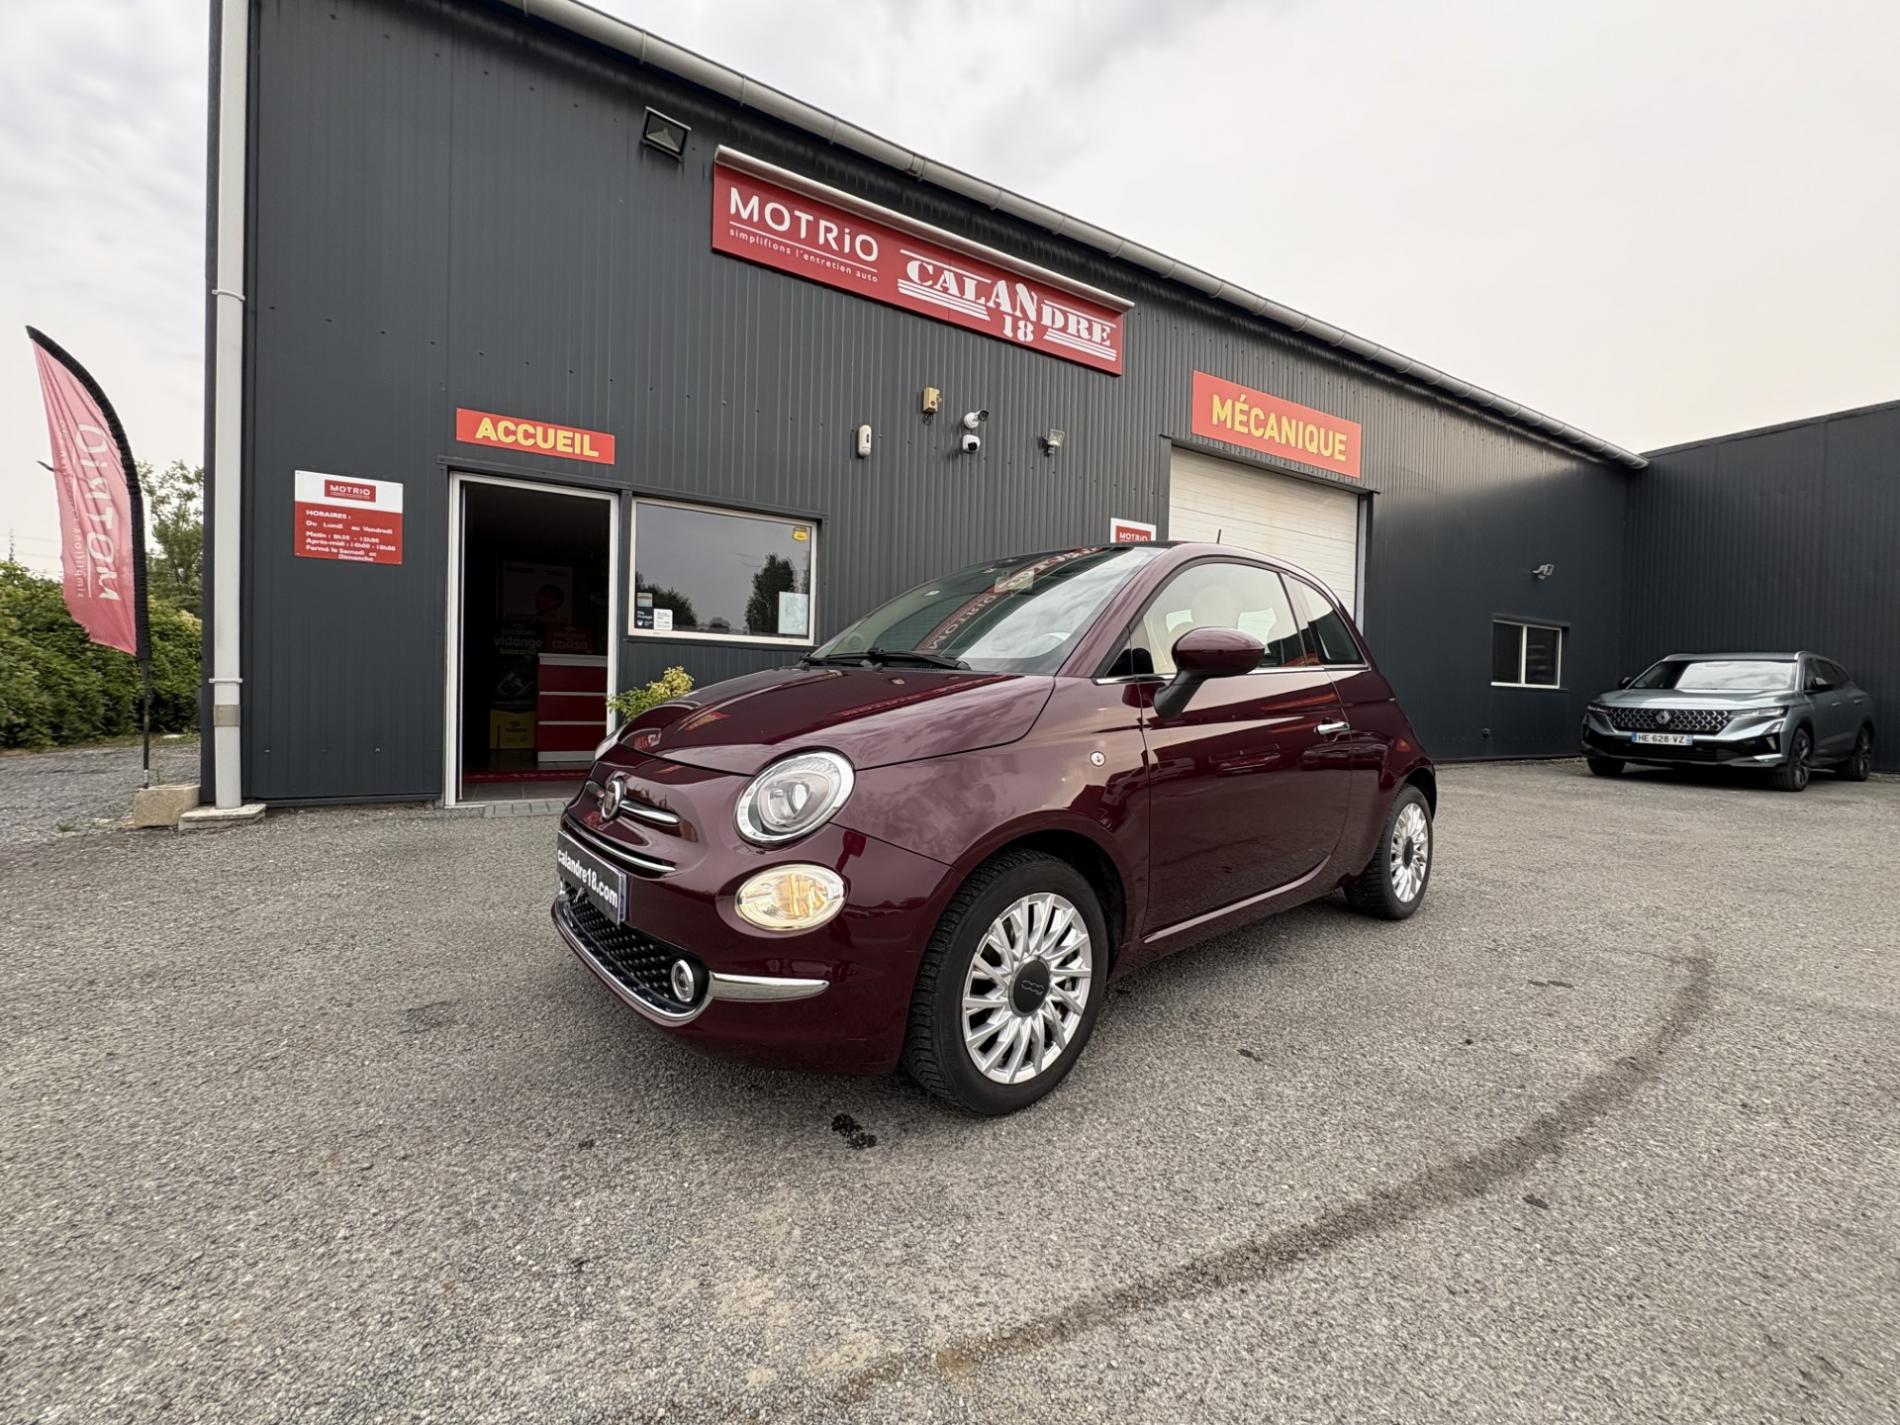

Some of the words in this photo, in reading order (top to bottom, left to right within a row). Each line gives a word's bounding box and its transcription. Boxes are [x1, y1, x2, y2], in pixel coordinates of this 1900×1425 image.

[729, 228, 791, 254] simplifions
[795, 248, 852, 275] l'entretien
[856, 269, 878, 283] auto
[906, 260, 1111, 347] CALANDRE
[1002, 314, 1034, 343] 18
[475, 417, 599, 457] ACCUEIL
[1212, 394, 1347, 462] MÉCANIQUE
[306, 544, 330, 552] Fermé
[339, 548, 365, 556] Samedi
[362, 526, 393, 534] Vendredi
[1672, 736, 1685, 744] VZ
[557, 849, 618, 908] calandre18.com
